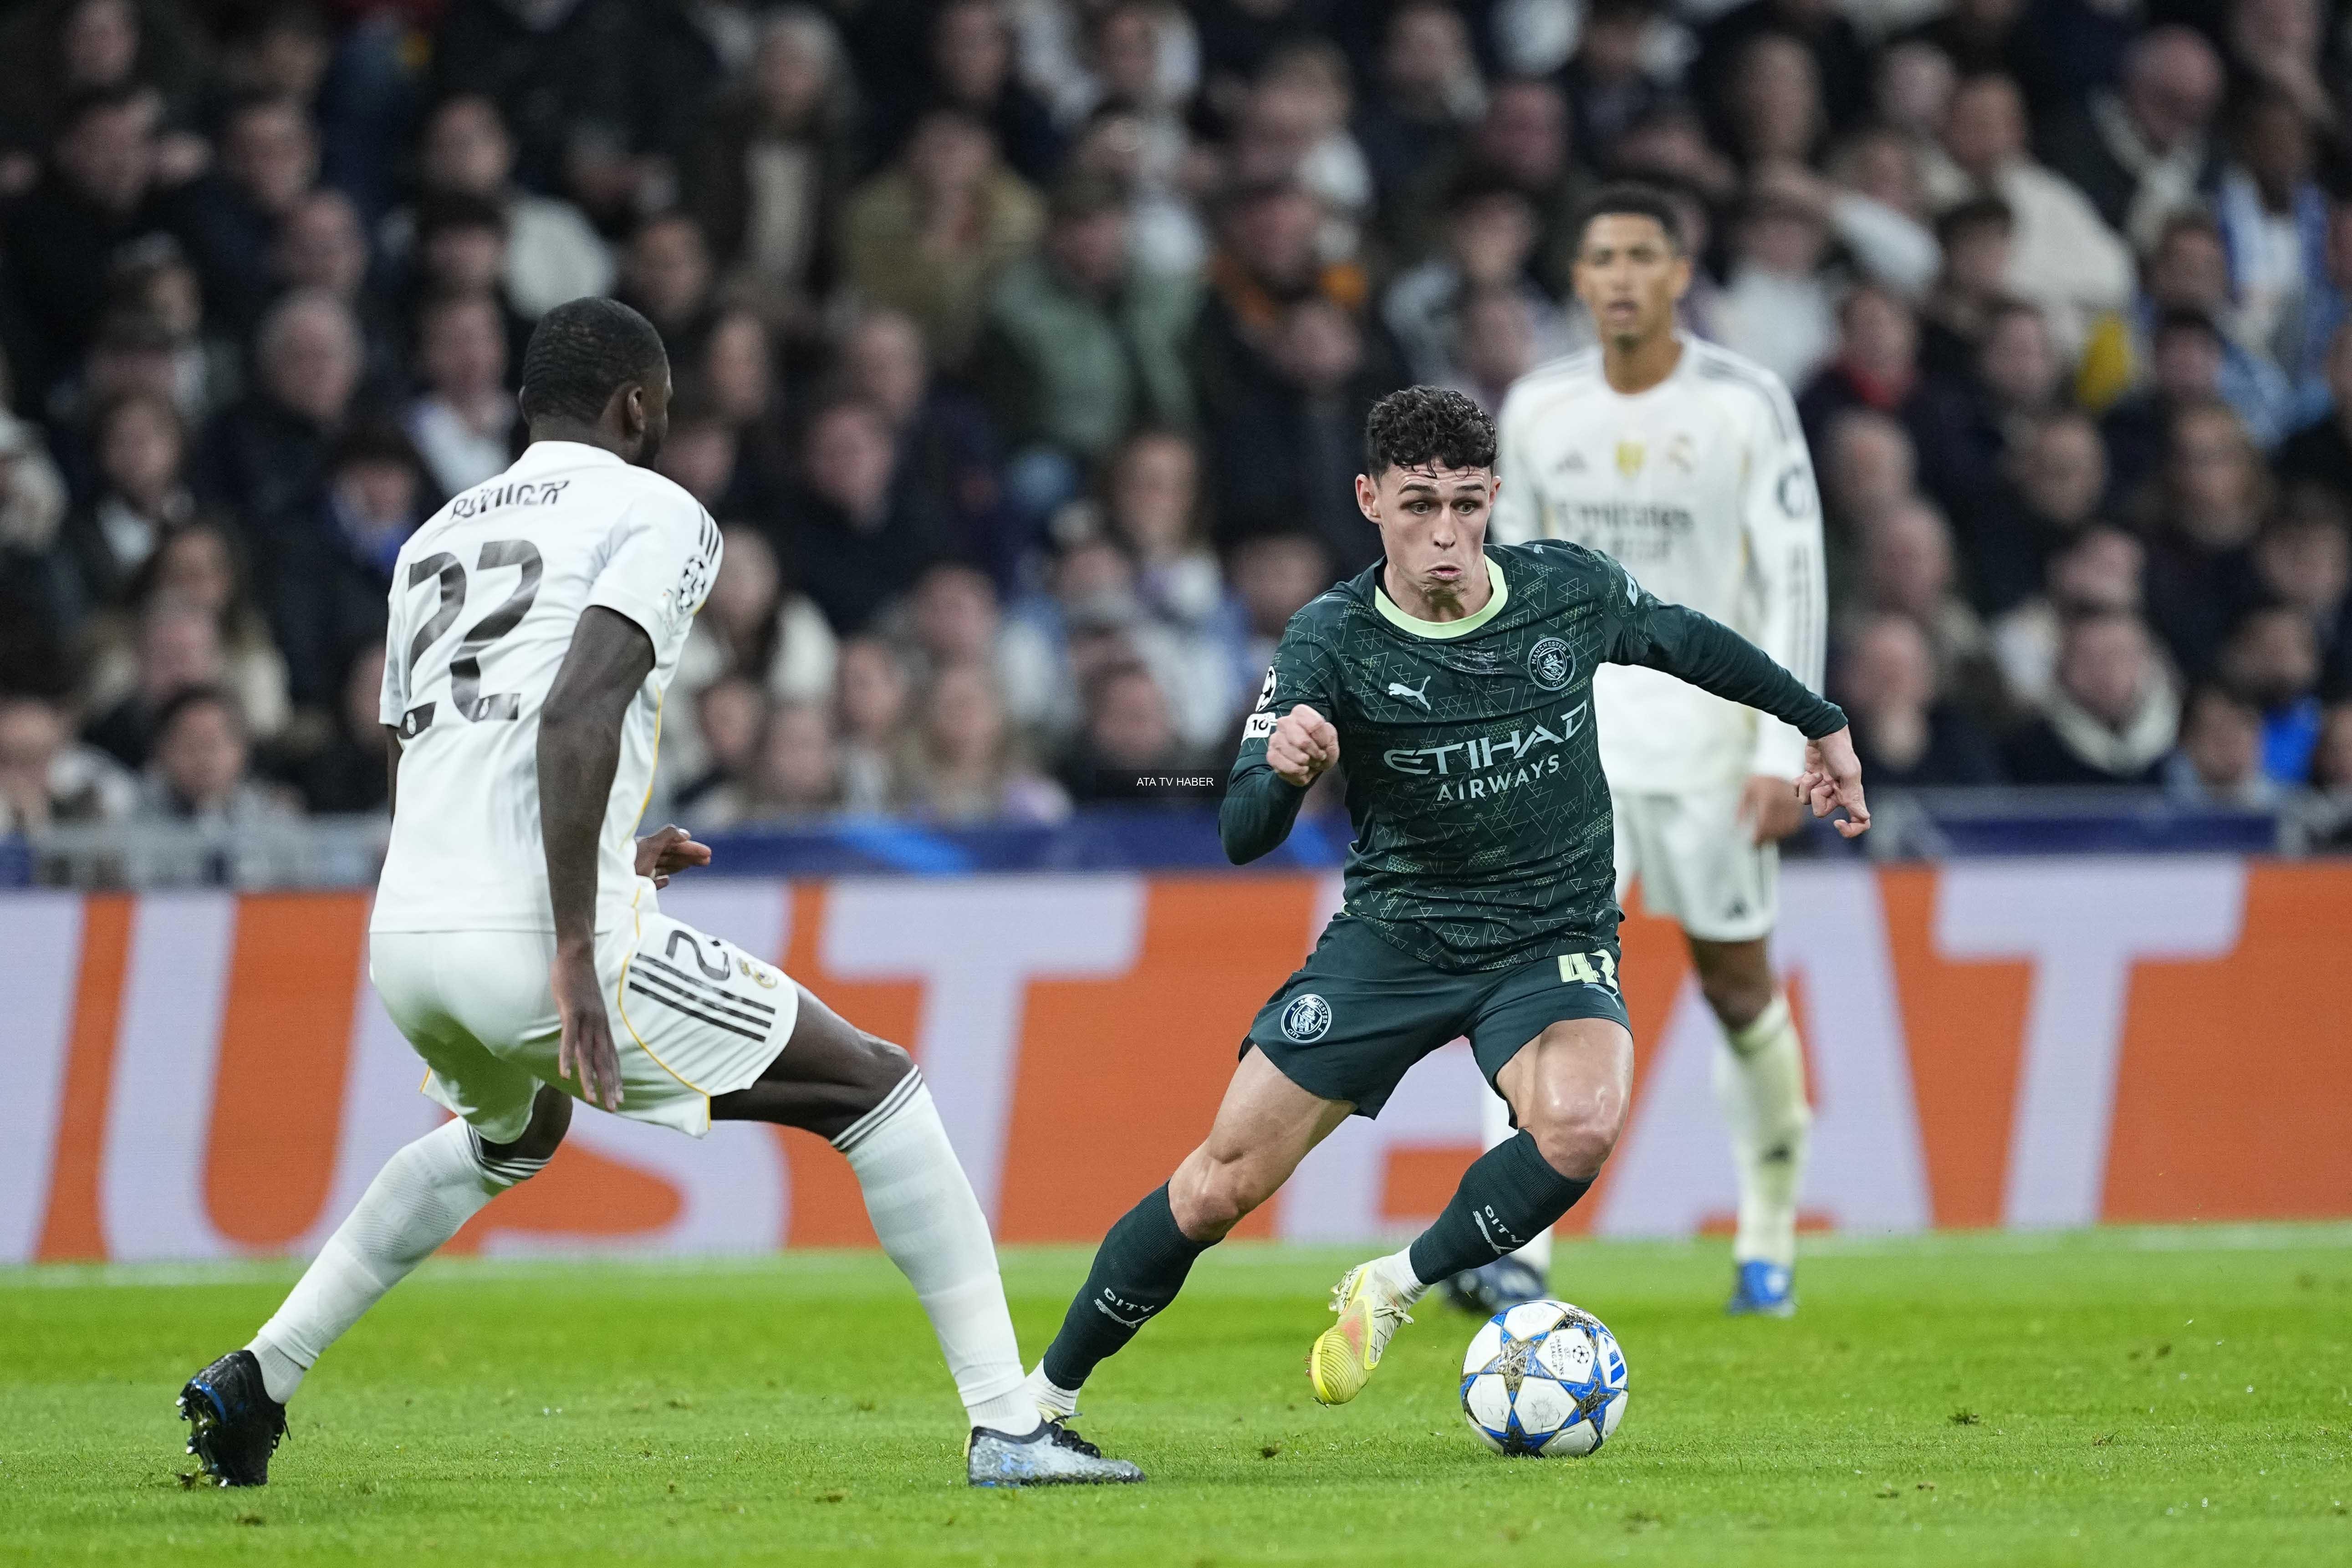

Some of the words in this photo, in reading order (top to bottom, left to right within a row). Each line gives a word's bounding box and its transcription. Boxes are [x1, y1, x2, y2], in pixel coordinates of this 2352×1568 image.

[397, 540, 543, 740] 22
[1531, 641, 1567, 664] MANCHESTER
[1552, 677, 1566, 687] CITY
[1383, 700, 1587, 775] ETIHAD
[1437, 754, 1559, 802] AIRWAYS
[1298, 998, 1328, 1024] MACHESTER
[1287, 1028, 1301, 1039] CITY
